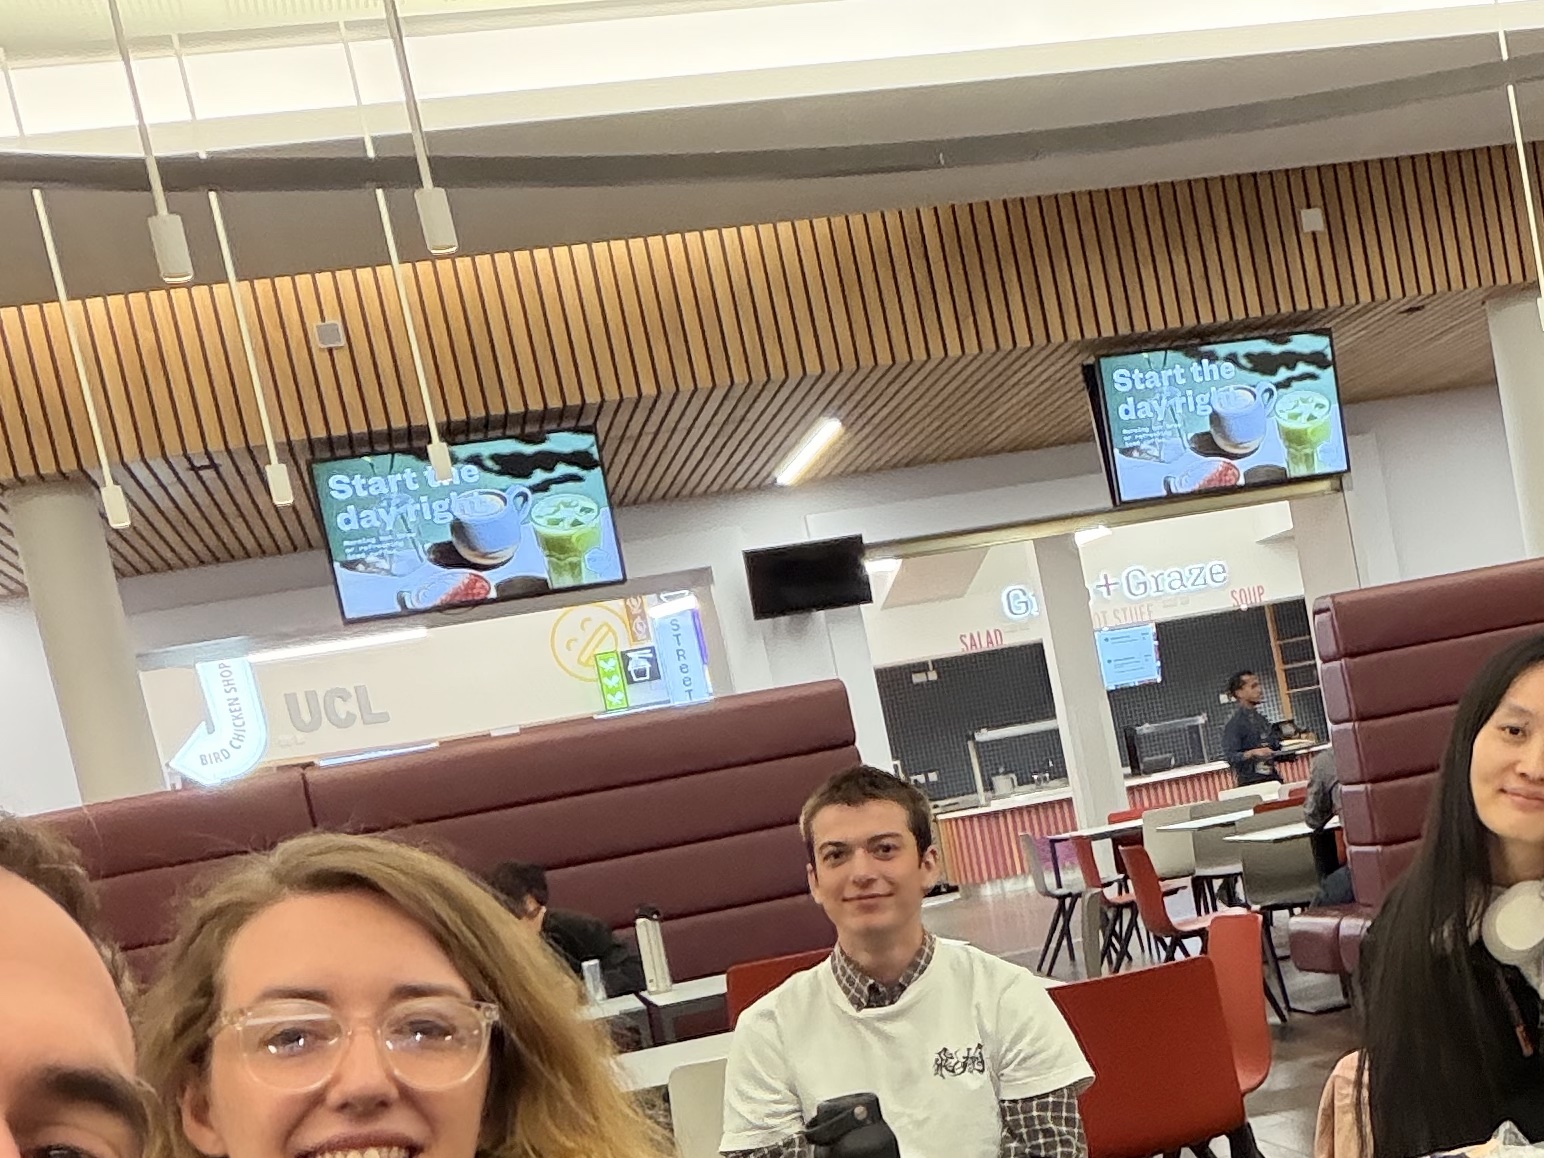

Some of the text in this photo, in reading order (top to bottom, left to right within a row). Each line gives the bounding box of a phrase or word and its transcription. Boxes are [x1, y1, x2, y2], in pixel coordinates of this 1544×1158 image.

[1113, 359, 1235, 392] Start the
[1118, 396, 1167, 421] day
[328, 468, 419, 500] Start
[336, 504, 405, 532] day
[1230, 585, 1265, 607] SOUP
[959, 628, 1004, 653] SALAD
[200, 662, 247, 766] BIRD CHICKEN SHOP
[284, 685, 390, 732] UCL
